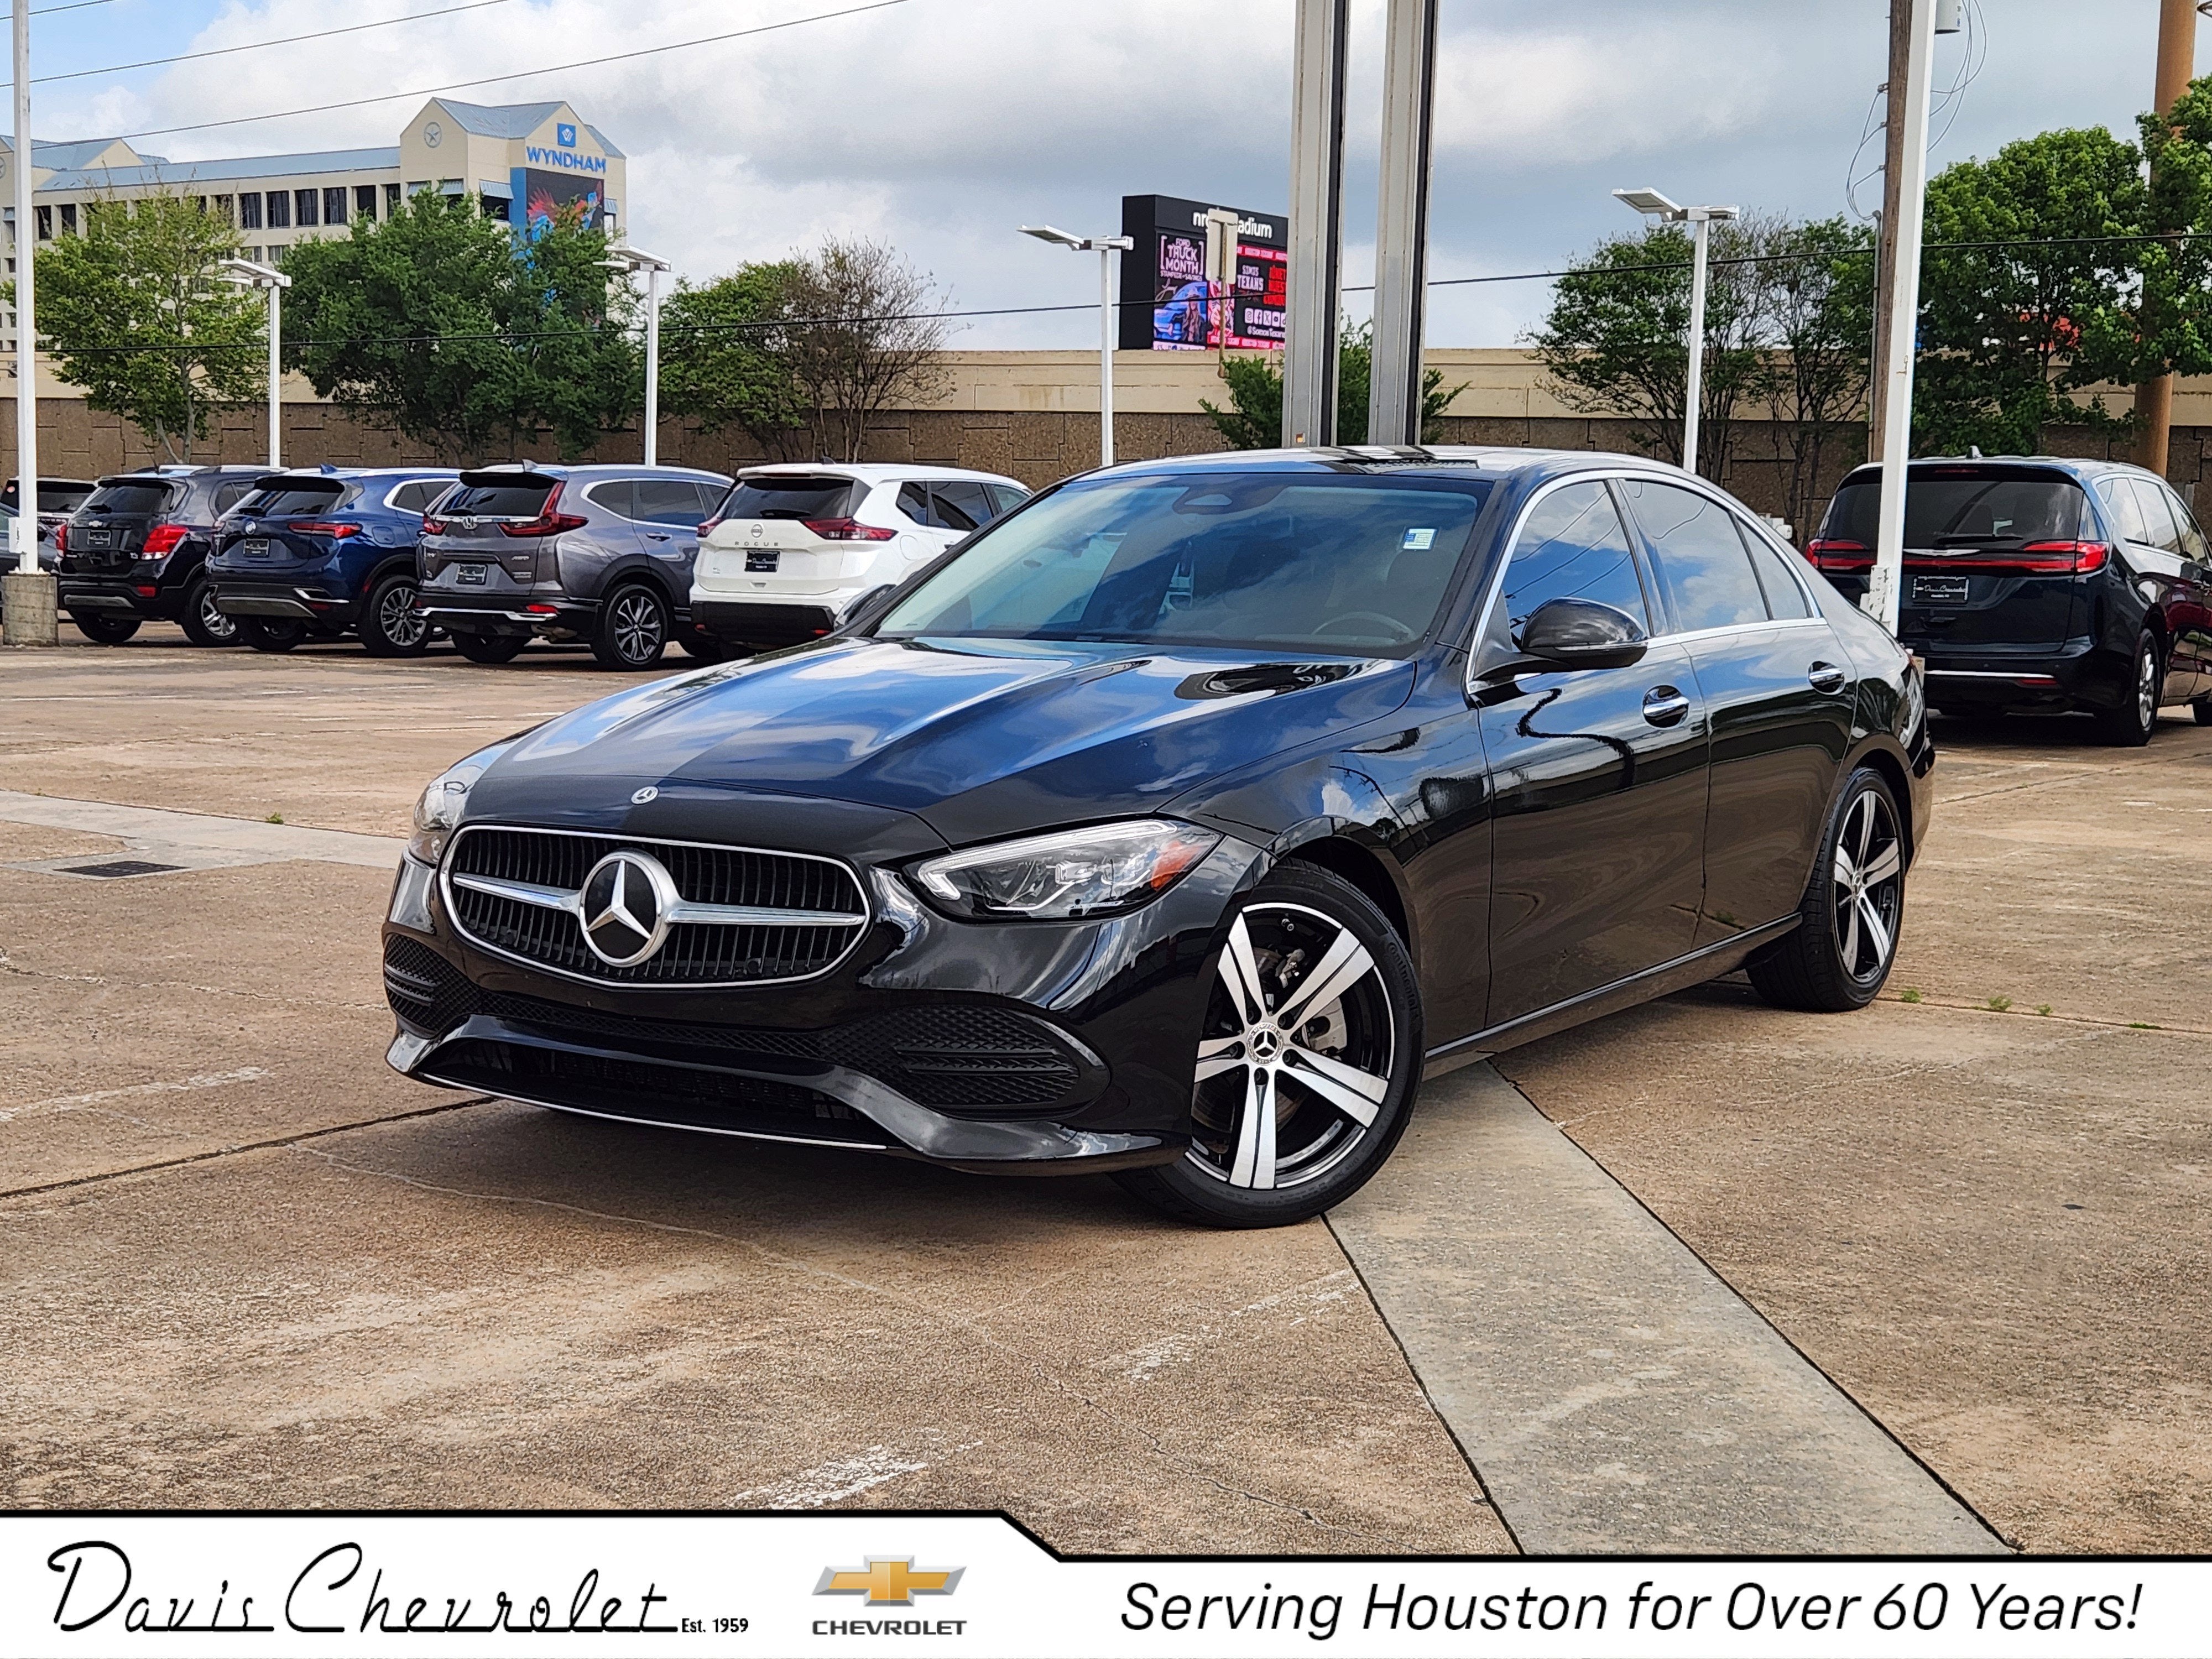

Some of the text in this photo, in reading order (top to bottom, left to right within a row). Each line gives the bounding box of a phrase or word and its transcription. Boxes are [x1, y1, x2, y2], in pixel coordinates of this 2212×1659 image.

[526, 146, 606, 173] WYNDHAM
[1192, 212, 1272, 239] nr adium
[1176, 238, 1191, 247] FORD
[1167, 244, 1197, 261] TRUCK
[1165, 257, 1199, 274] MONTH
[1237, 274, 1264, 291] TEXANS
